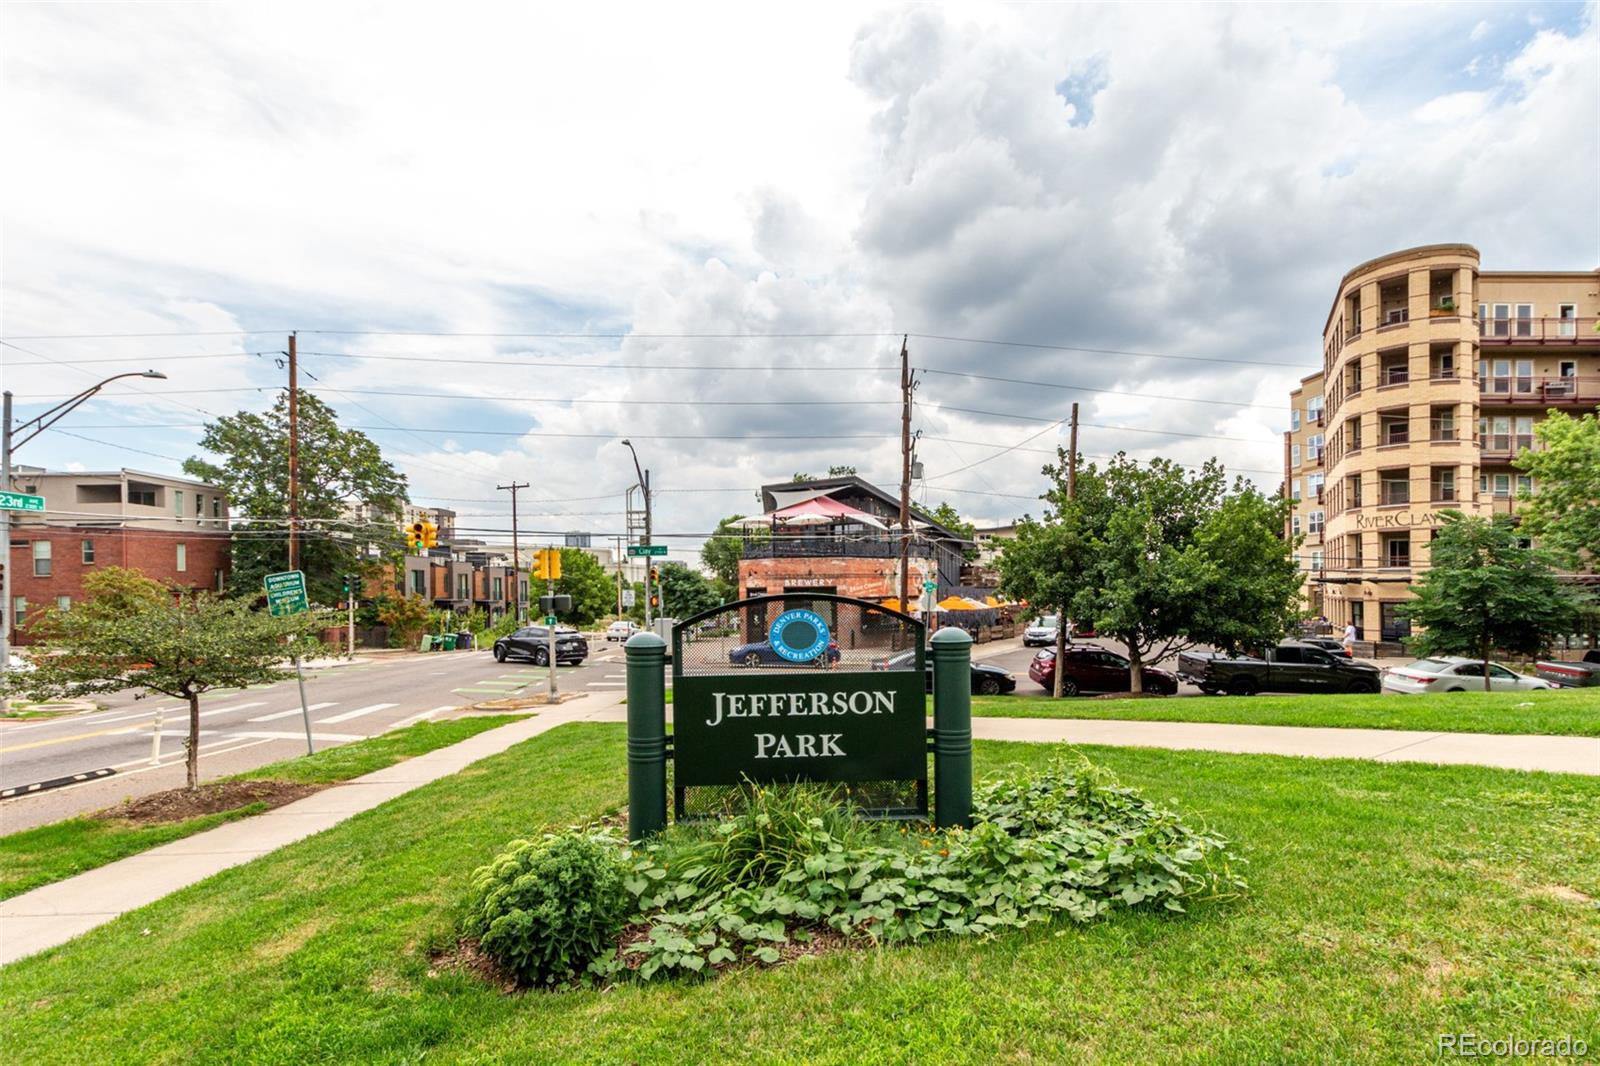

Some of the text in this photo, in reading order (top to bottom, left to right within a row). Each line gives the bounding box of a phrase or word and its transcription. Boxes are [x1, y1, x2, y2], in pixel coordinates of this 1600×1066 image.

[0, 495, 23, 508] 23rd
[268, 573, 299, 583] DOWNTOWN
[784, 578, 833, 587] BREWERY
[773, 612, 826, 634] DENVER PARKS
[778, 640, 825, 660] RECREATION
[705, 690, 897, 727] JEFFERSON
[753, 733, 847, 759] PARK
